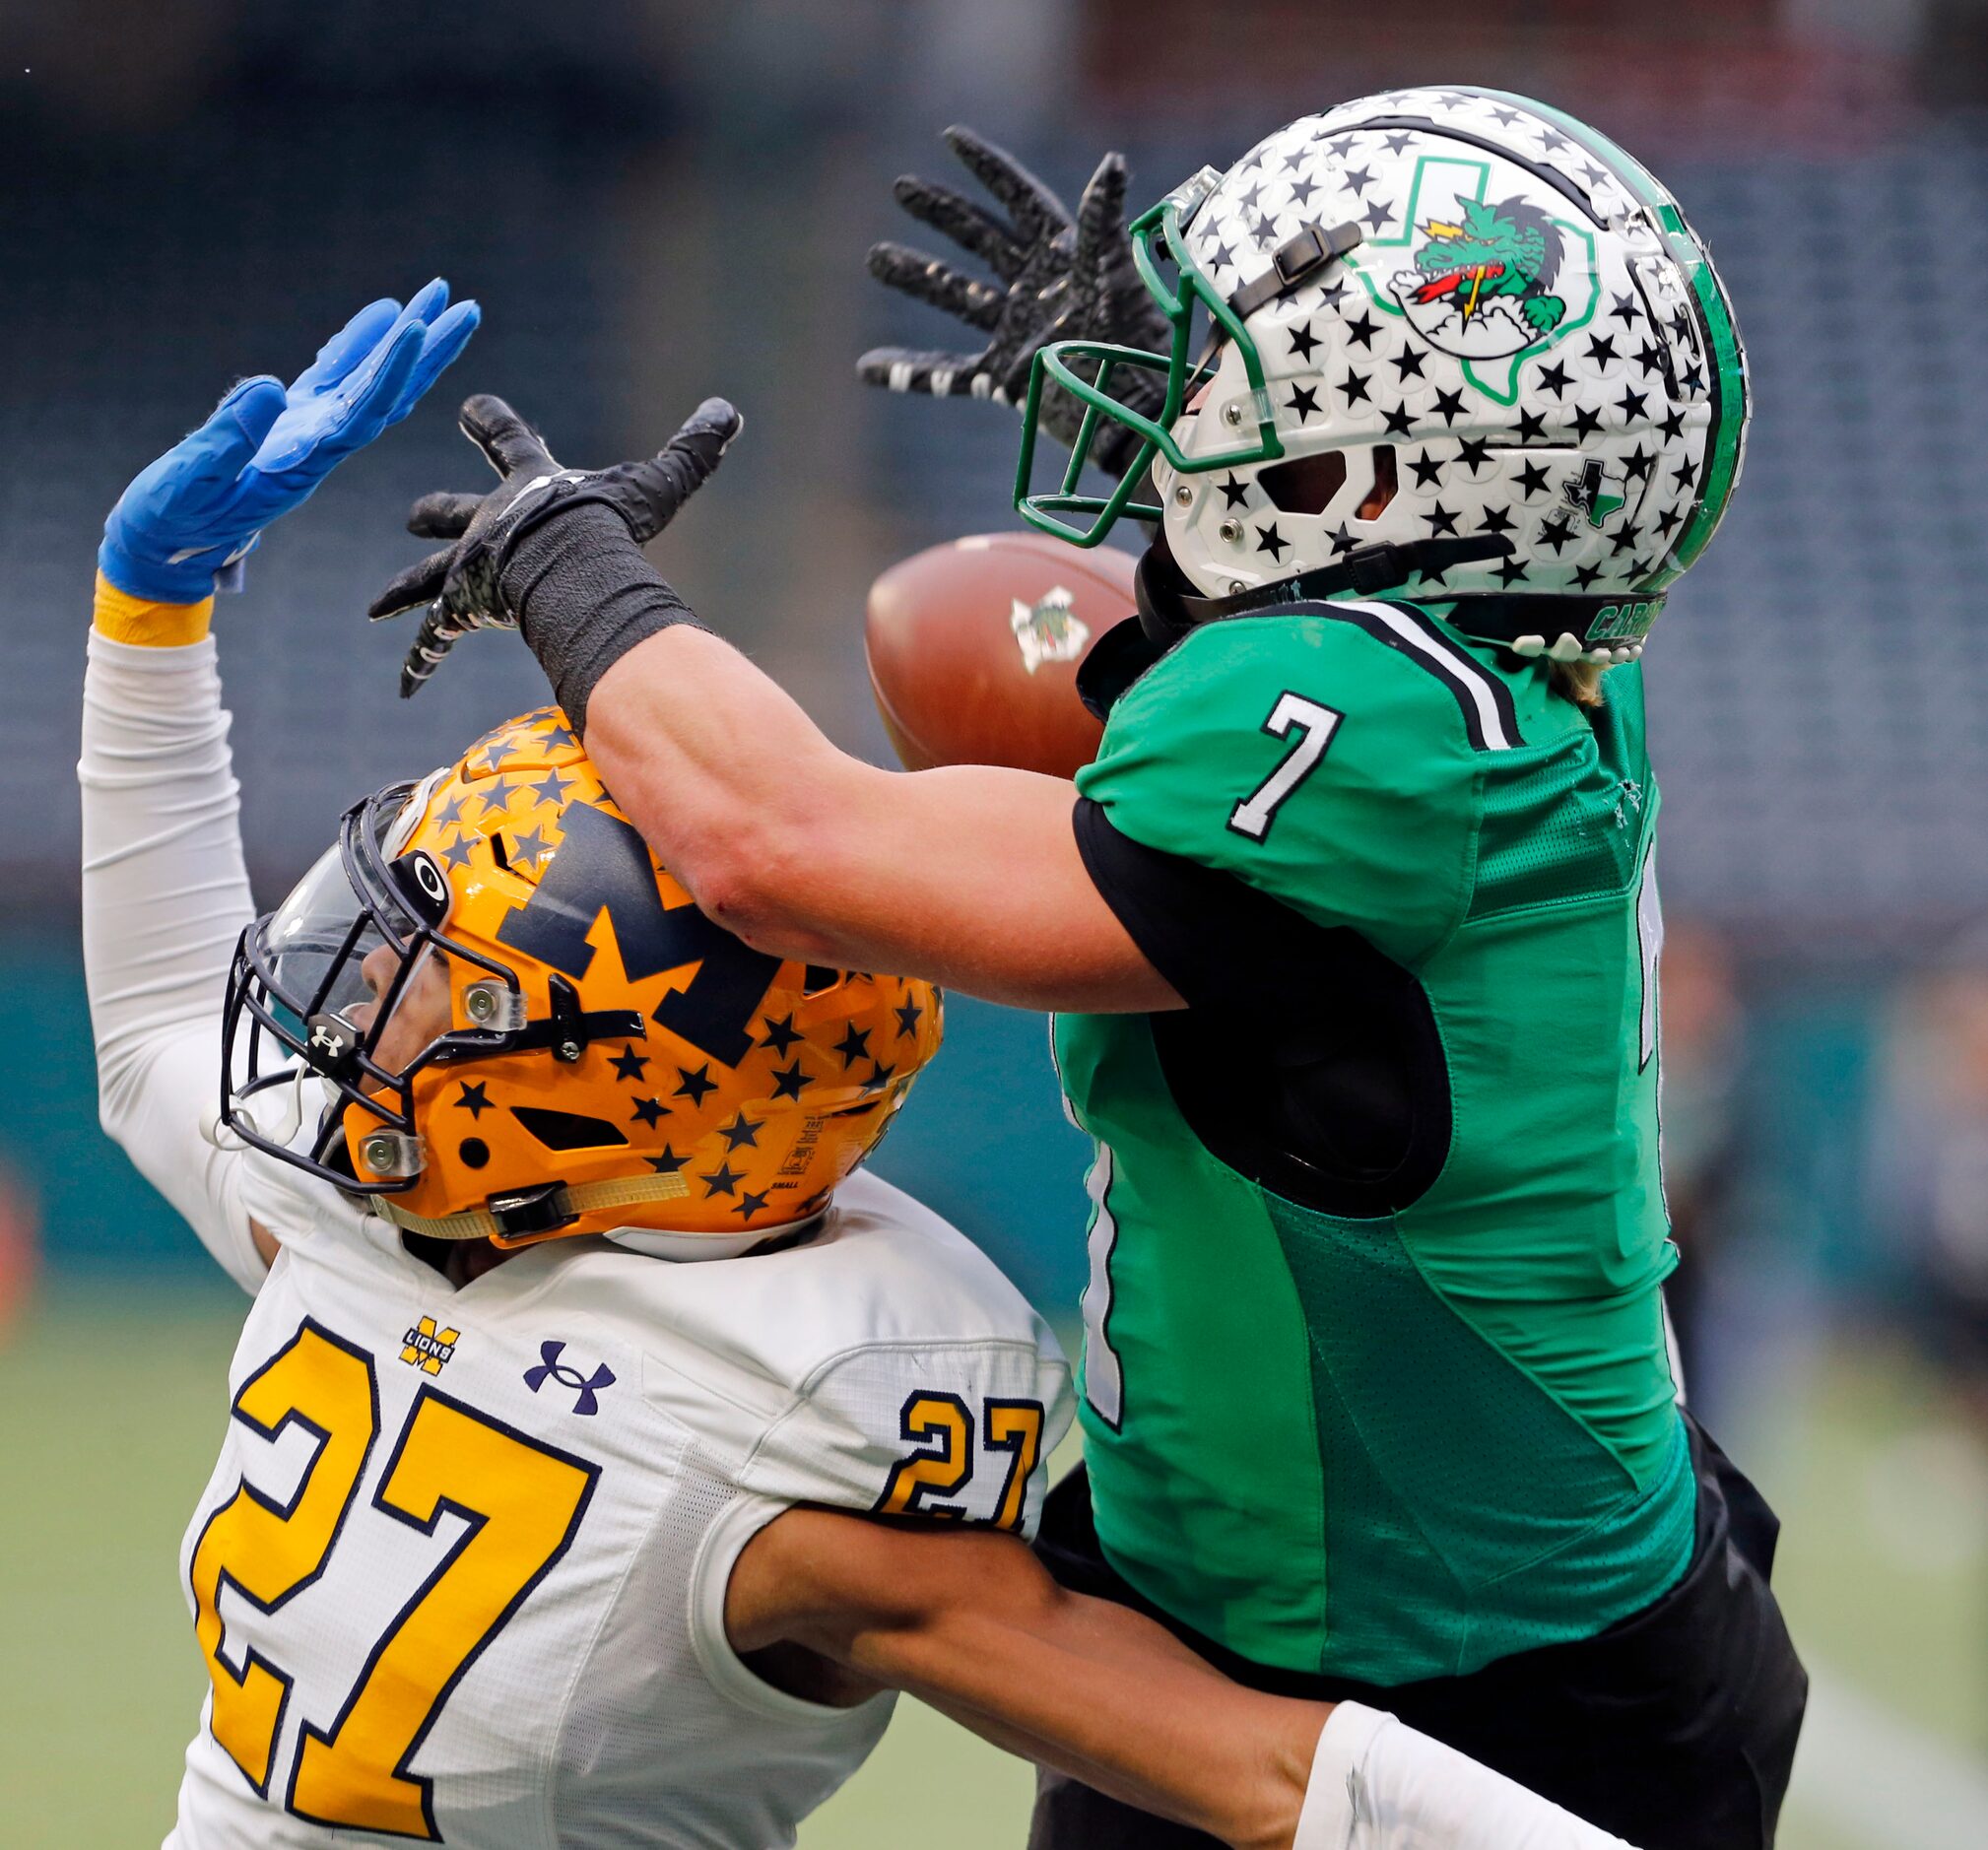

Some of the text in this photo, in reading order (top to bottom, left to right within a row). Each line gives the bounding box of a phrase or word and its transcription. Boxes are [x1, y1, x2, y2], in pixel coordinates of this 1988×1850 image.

[1226, 690, 1347, 846] 7
[404, 1330, 452, 1361] LIONS
[872, 1389, 1045, 1534] 27
[190, 1315, 602, 1844] 27
